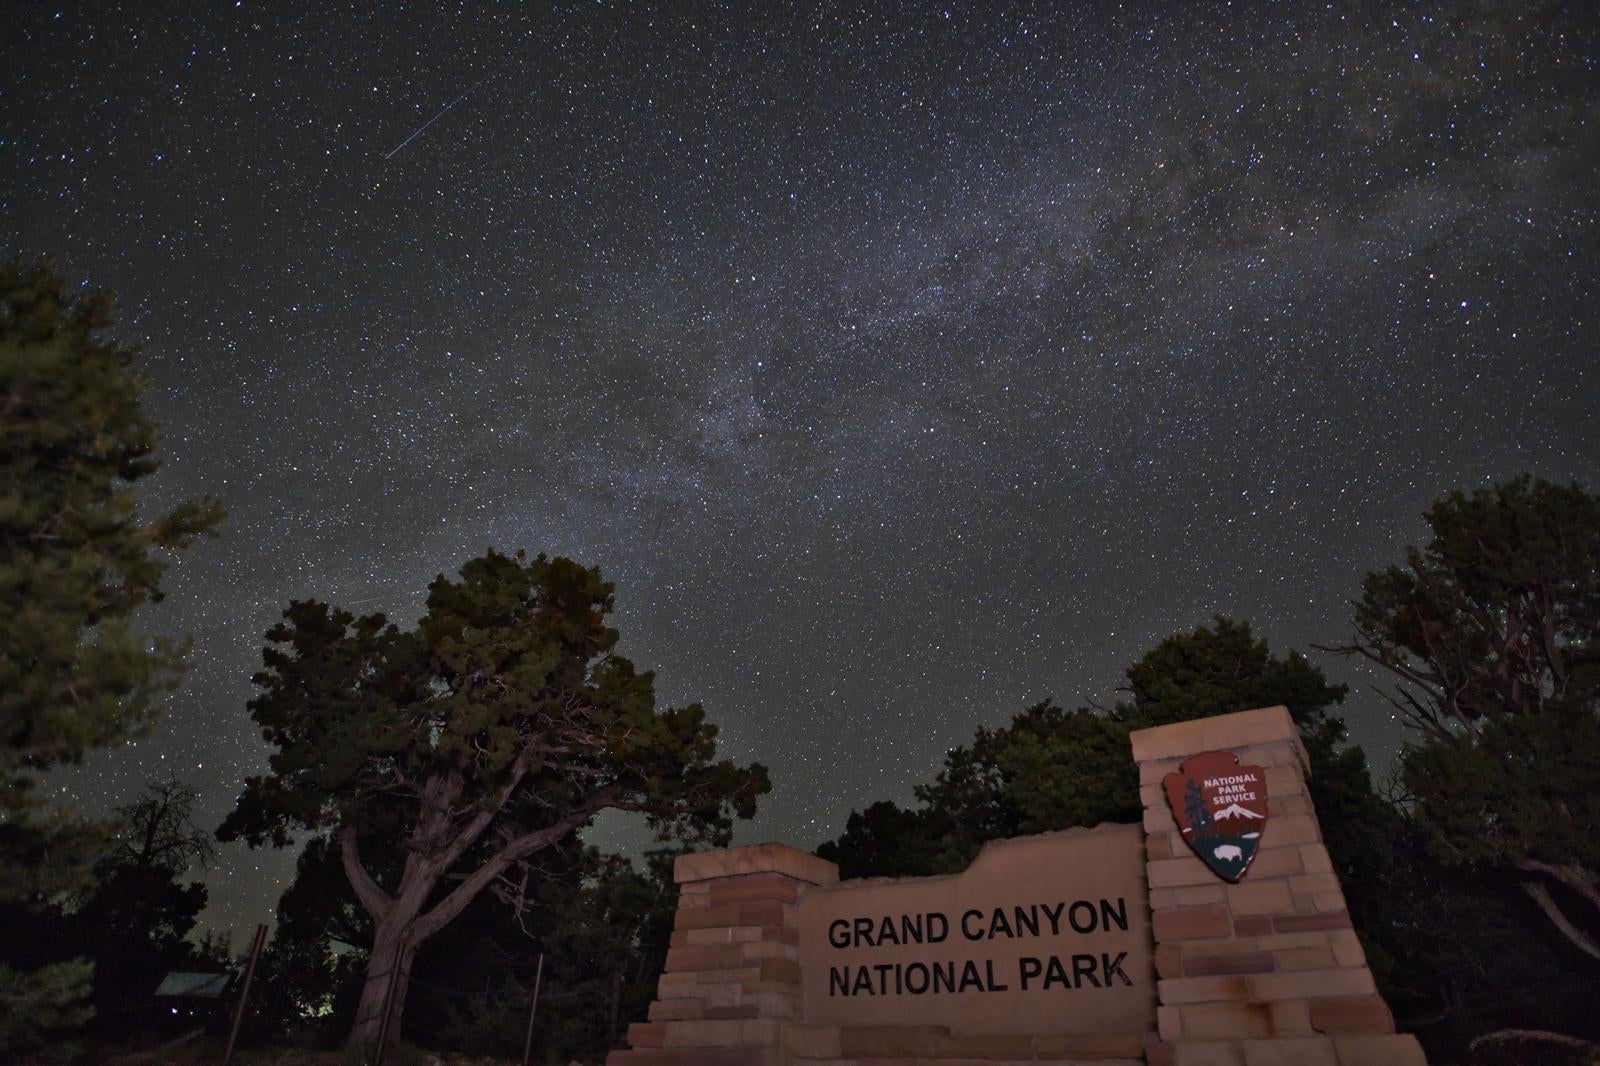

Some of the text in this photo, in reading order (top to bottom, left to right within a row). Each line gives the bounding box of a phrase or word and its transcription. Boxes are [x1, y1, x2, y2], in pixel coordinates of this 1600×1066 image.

[1203, 773, 1258, 788] NATIONAL
[1218, 784, 1247, 795] PARK
[1212, 792, 1257, 805] SERVICE
[828, 898, 1129, 949] GRAND CANYON
[829, 951, 1134, 997] NATIONAL PARK
